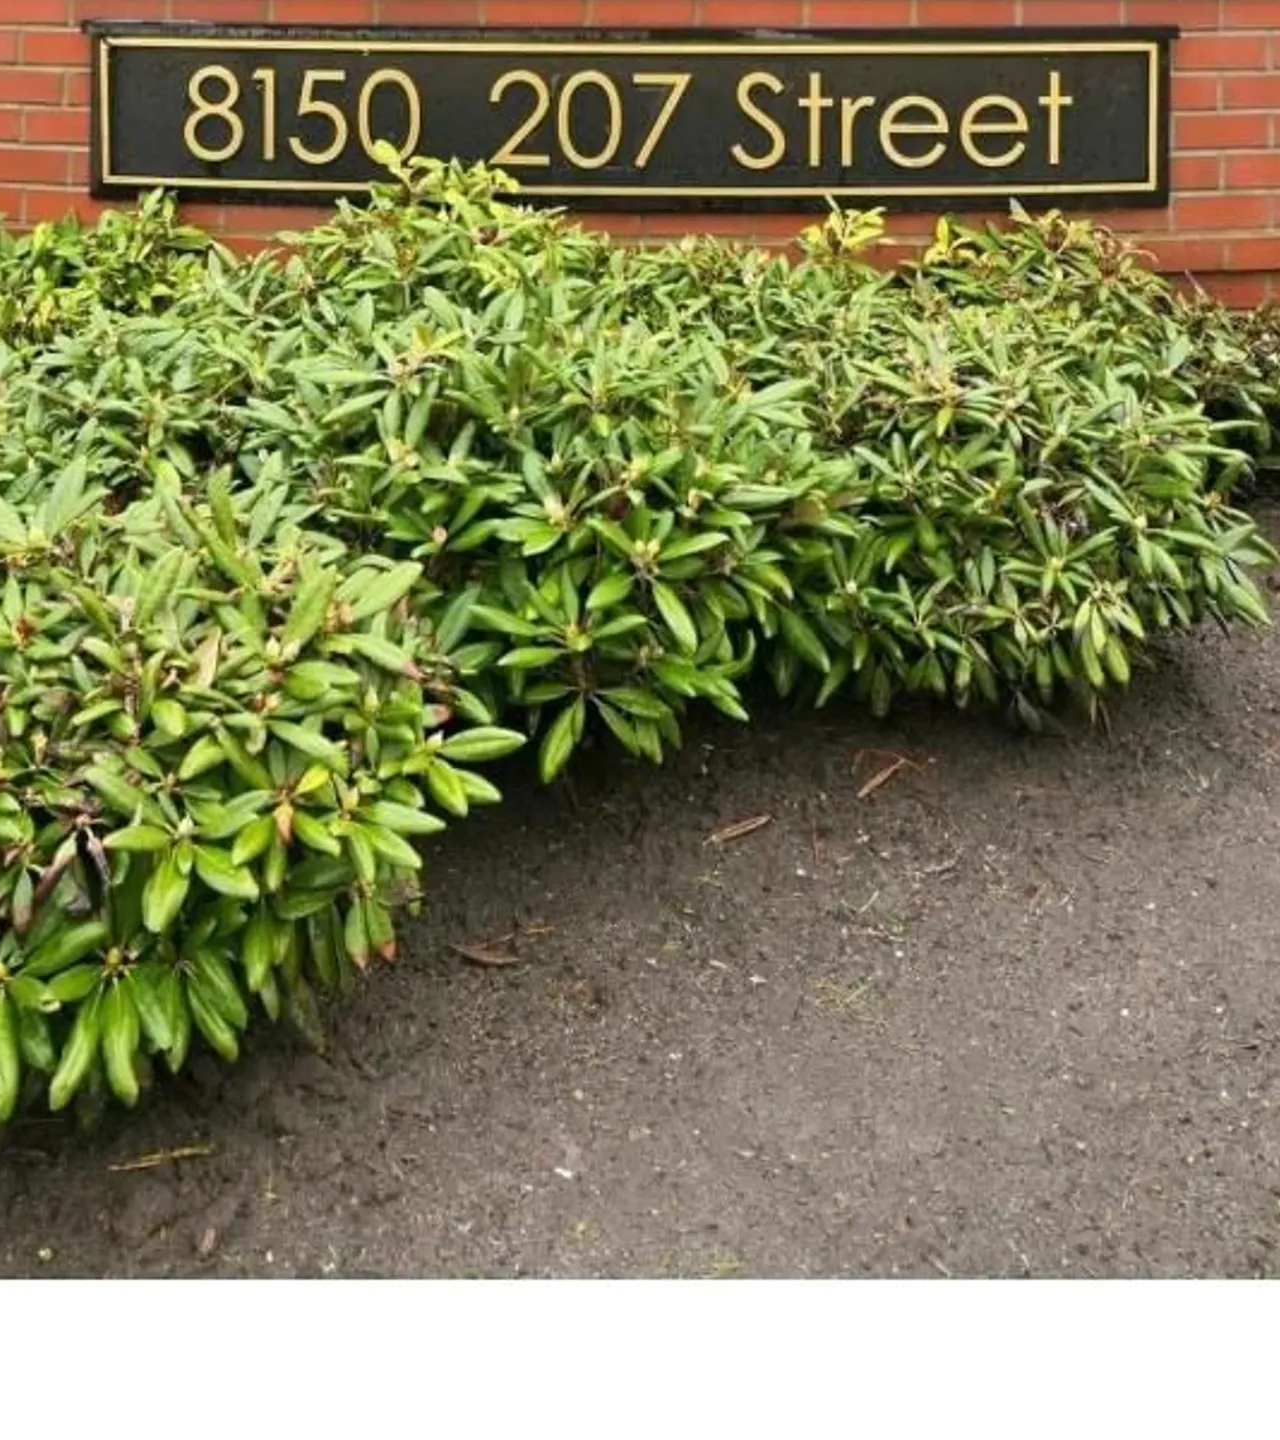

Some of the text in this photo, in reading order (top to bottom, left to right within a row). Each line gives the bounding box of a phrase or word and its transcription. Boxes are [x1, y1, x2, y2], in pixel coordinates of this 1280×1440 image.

[183, 64, 1073, 169] 8150 207 Street
